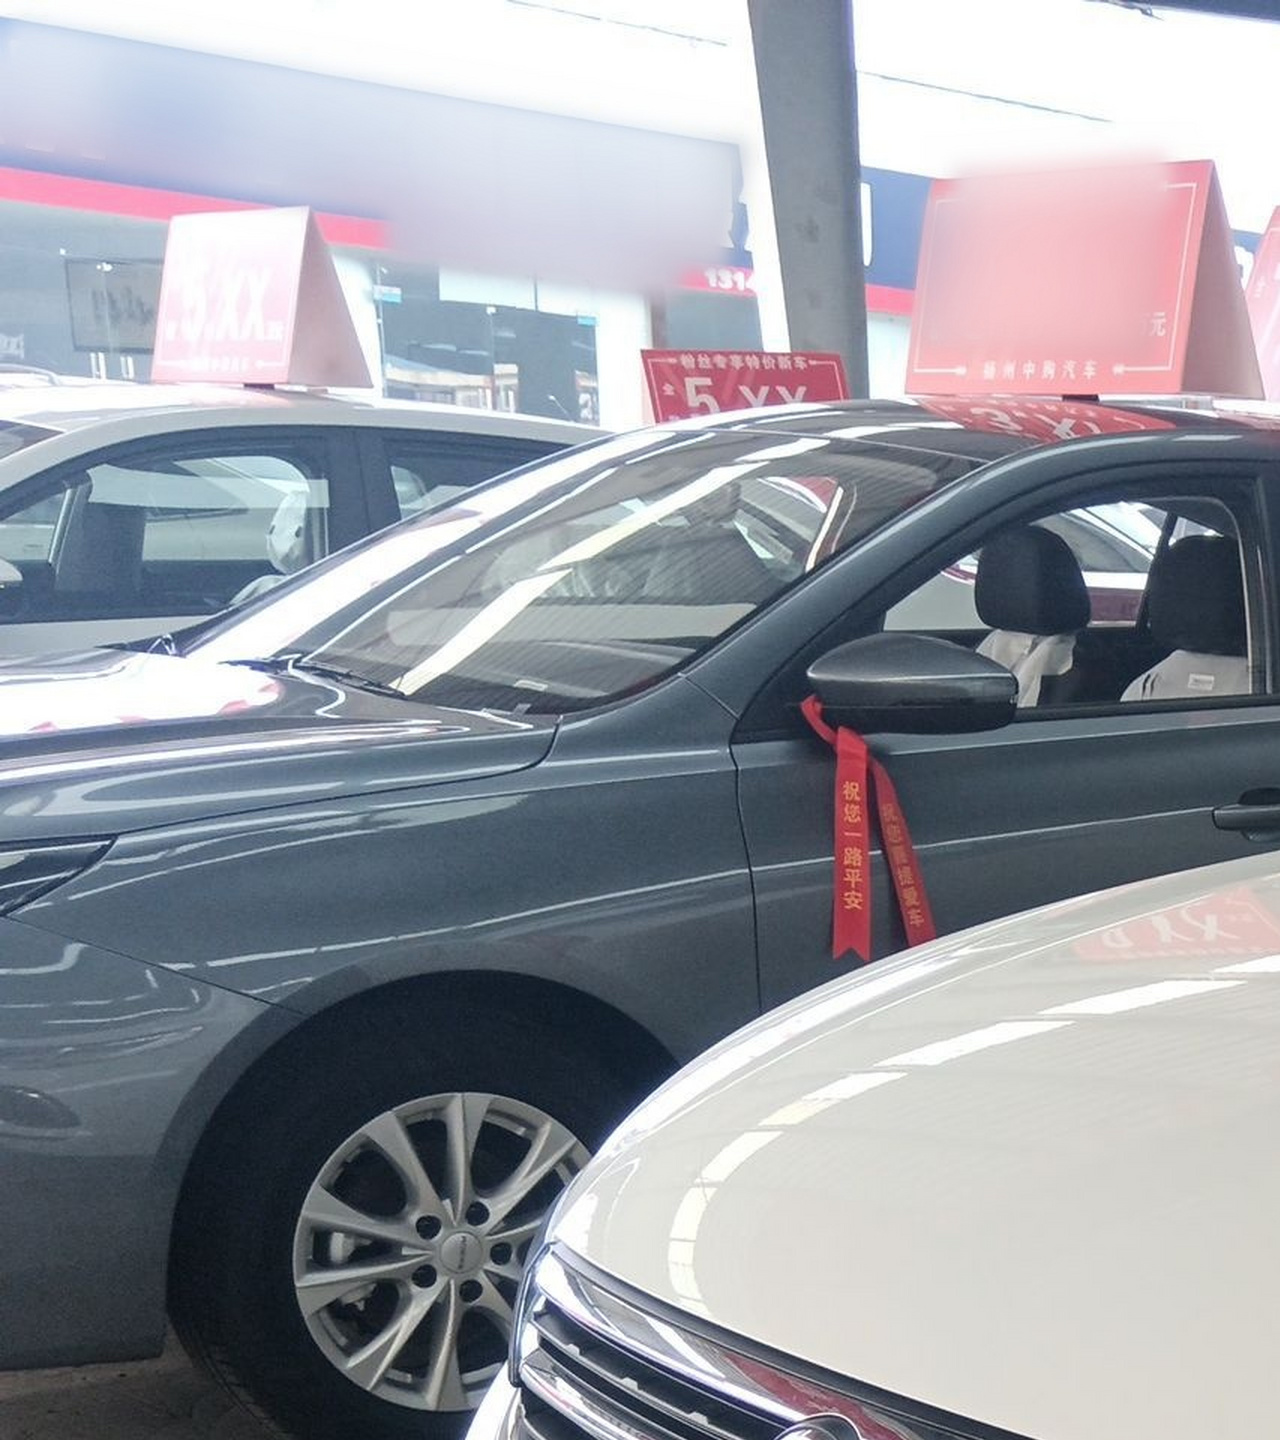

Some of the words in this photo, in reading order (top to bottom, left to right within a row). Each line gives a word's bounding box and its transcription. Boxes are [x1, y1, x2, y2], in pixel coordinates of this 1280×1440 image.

[843, 780, 863, 910] 祝您一路平安
